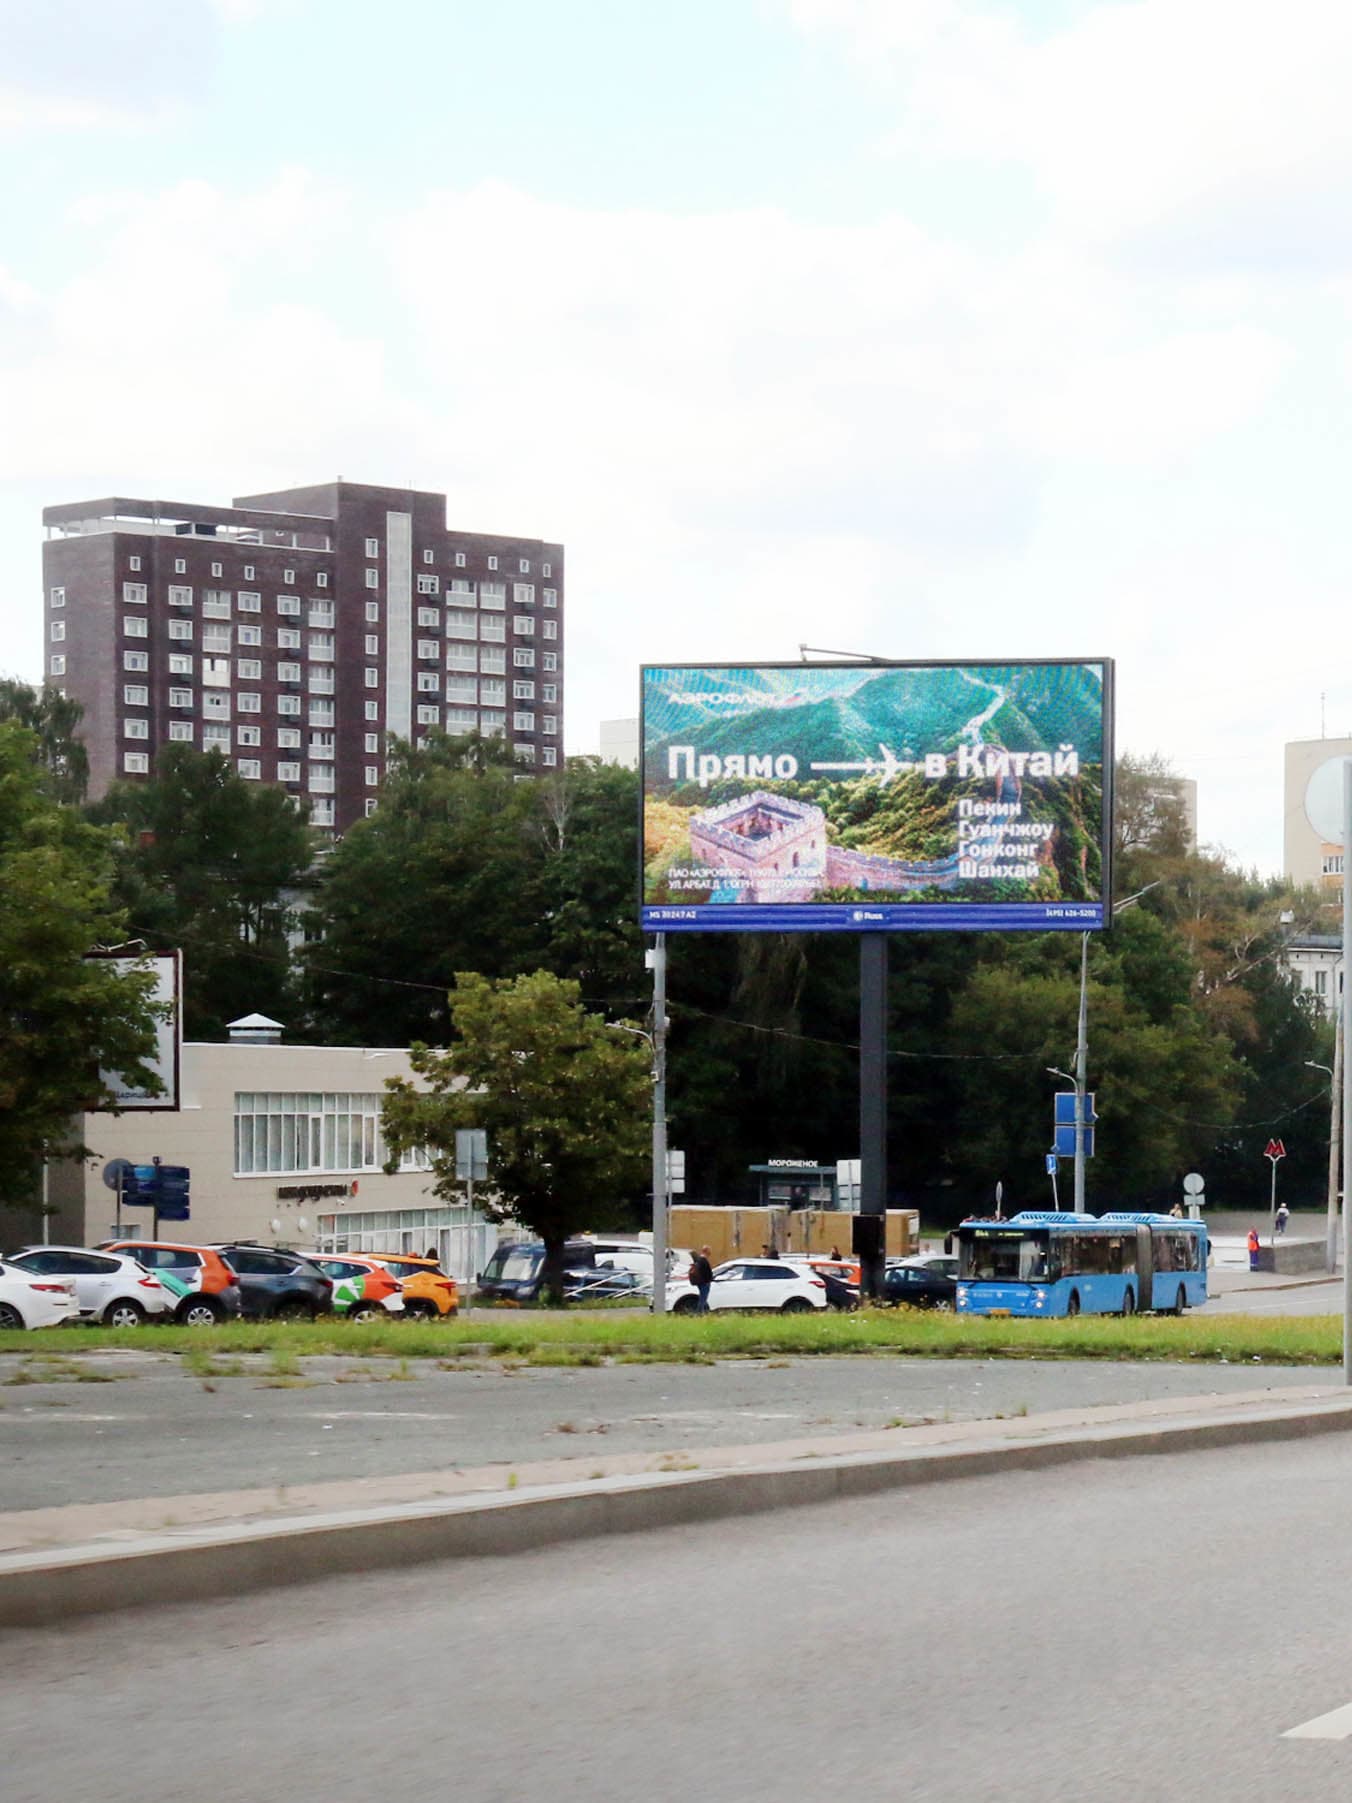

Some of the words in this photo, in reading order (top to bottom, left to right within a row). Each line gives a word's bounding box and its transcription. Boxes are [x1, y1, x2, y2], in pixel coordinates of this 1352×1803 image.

[668, 745, 799, 788] Прямо
[925, 753, 948, 778] в
[958, 744, 1080, 777] Китай
[959, 799, 1022, 816] Пекин
[959, 820, 1055, 840] Гуанчжоу
[959, 840, 1040, 857] Гонконг
[959, 860, 1040, 879] Шанхай
[768, 1159, 818, 1168] МОРОЖЕНОЕ
